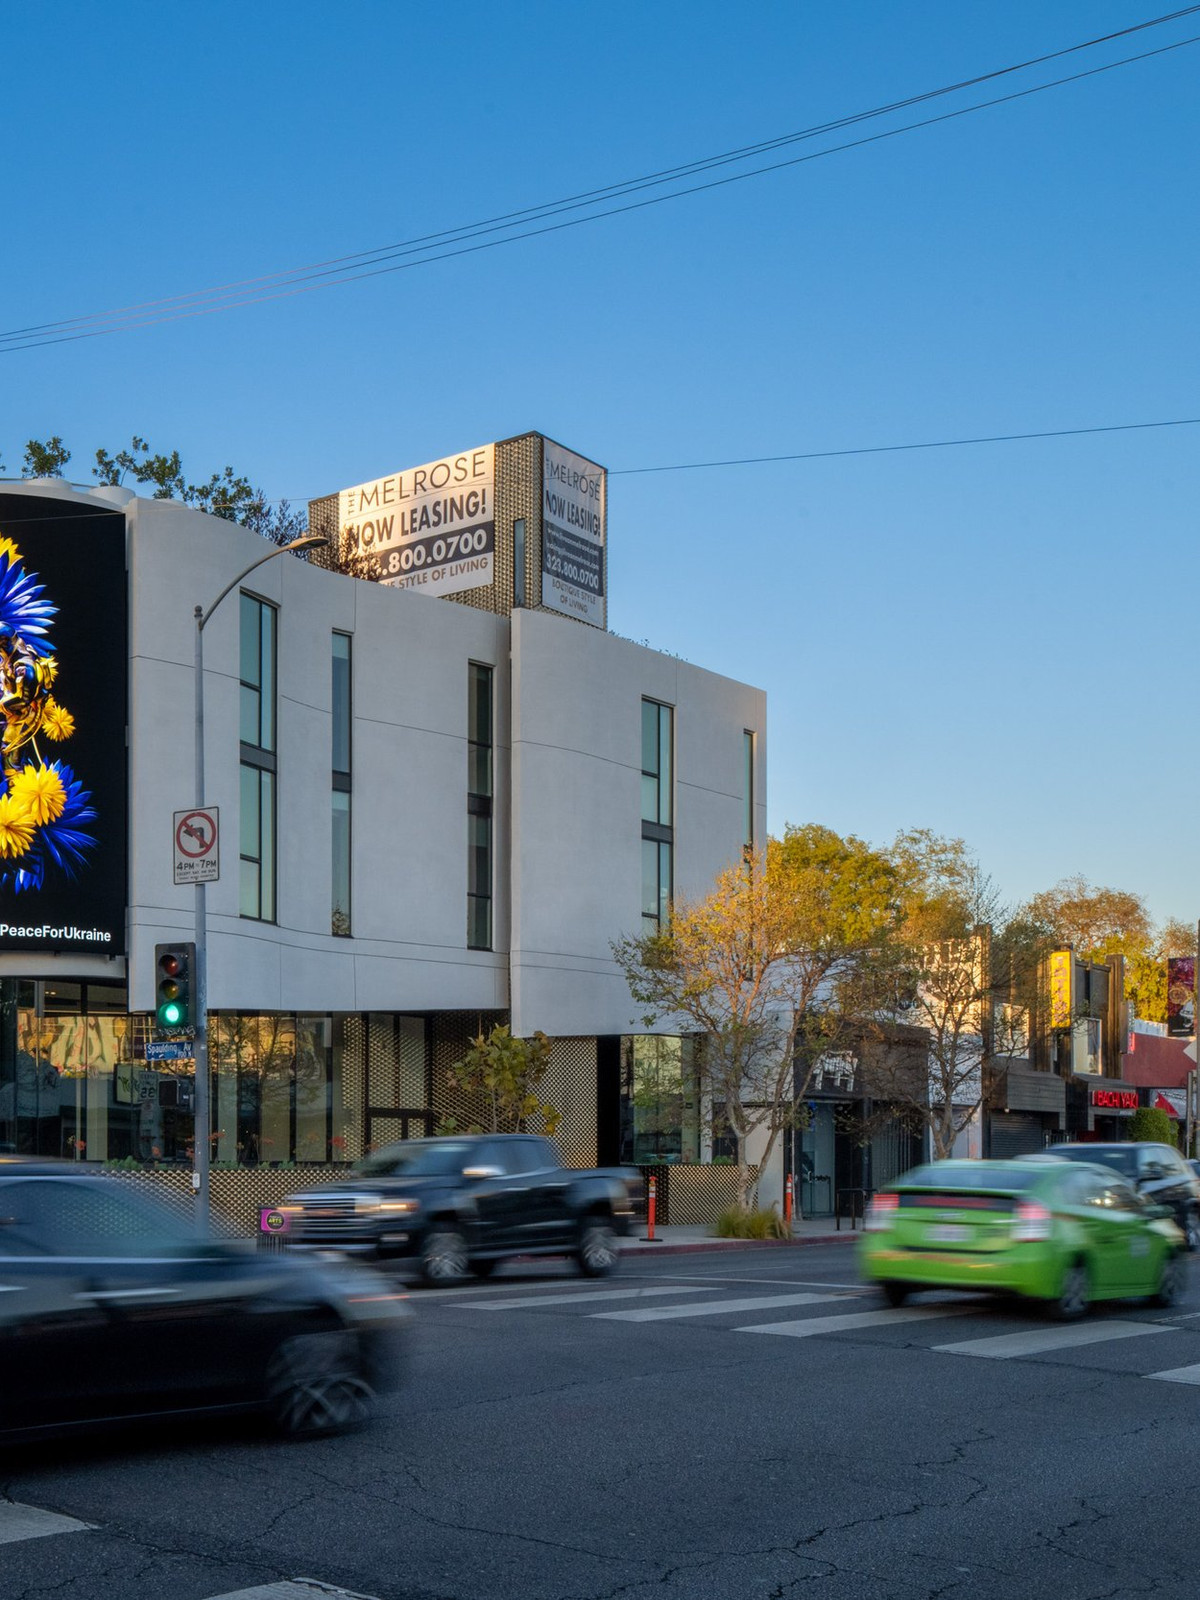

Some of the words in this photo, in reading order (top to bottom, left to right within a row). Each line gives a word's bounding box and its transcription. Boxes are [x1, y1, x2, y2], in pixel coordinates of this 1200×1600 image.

[347, 490, 356, 515] THE
[359, 450, 486, 512] MELROSE
[550, 460, 600, 502] MELROSE
[401, 488, 487, 536] LEASING!
[545, 489, 566, 519] NOW
[567, 501, 600, 537] LEASING!
[380, 528, 488, 576] .800.0700
[546, 553, 599, 589] 323.800.0700
[398, 572, 428, 590] STYLE
[432, 568, 447, 582] OF
[450, 557, 489, 577] LIVING
[569, 597, 588, 614] LIVING
[147, 1044, 178, 1056] Spaulding
[183, 1042, 192, 1051] Av
